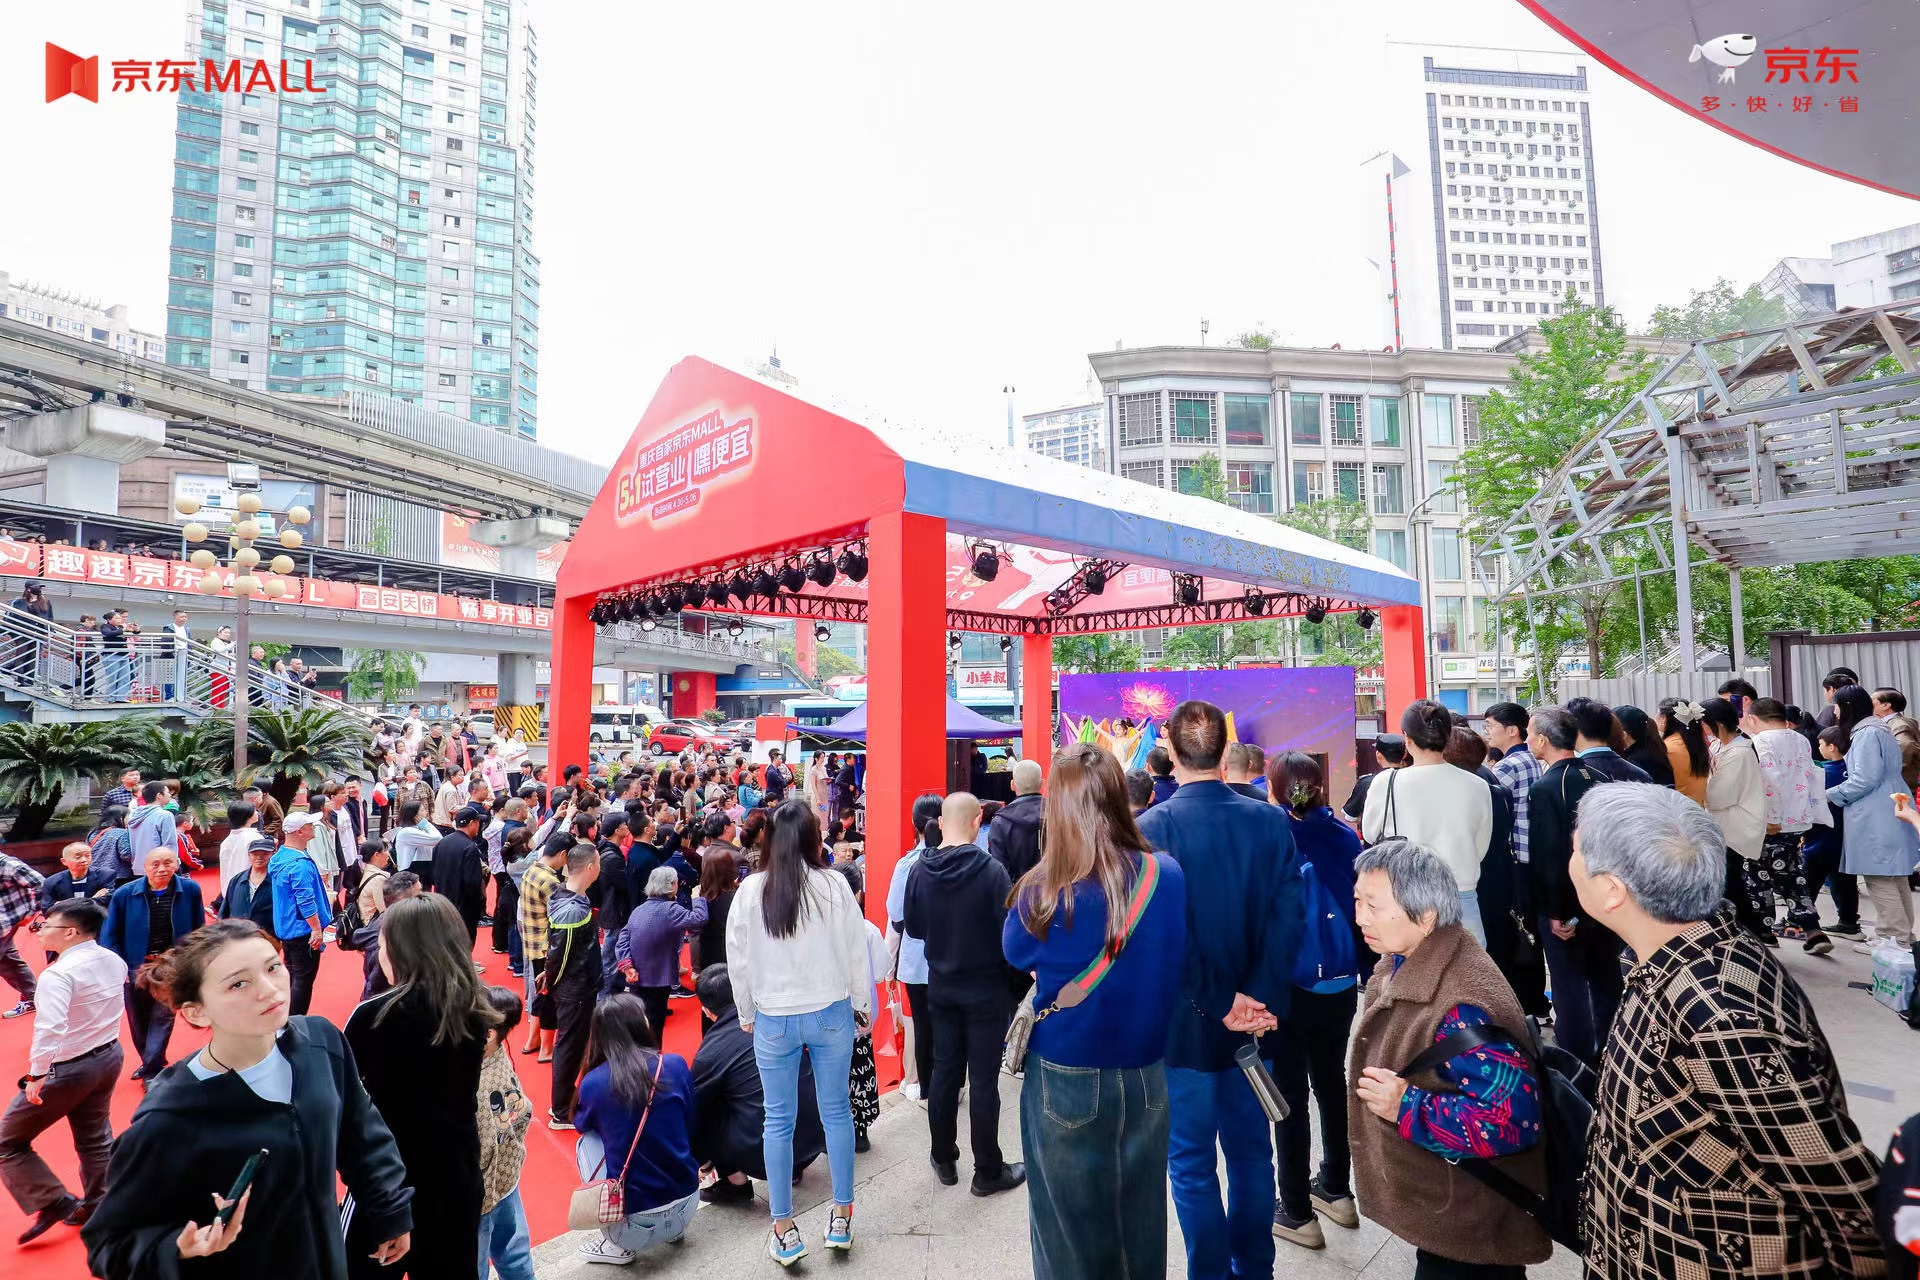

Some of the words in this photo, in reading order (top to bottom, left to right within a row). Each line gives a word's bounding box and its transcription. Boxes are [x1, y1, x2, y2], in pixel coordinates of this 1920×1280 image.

[640, 415, 721, 469] 重庆首家京东MALL
[461, 600, 553, 628] 畅享开业百
